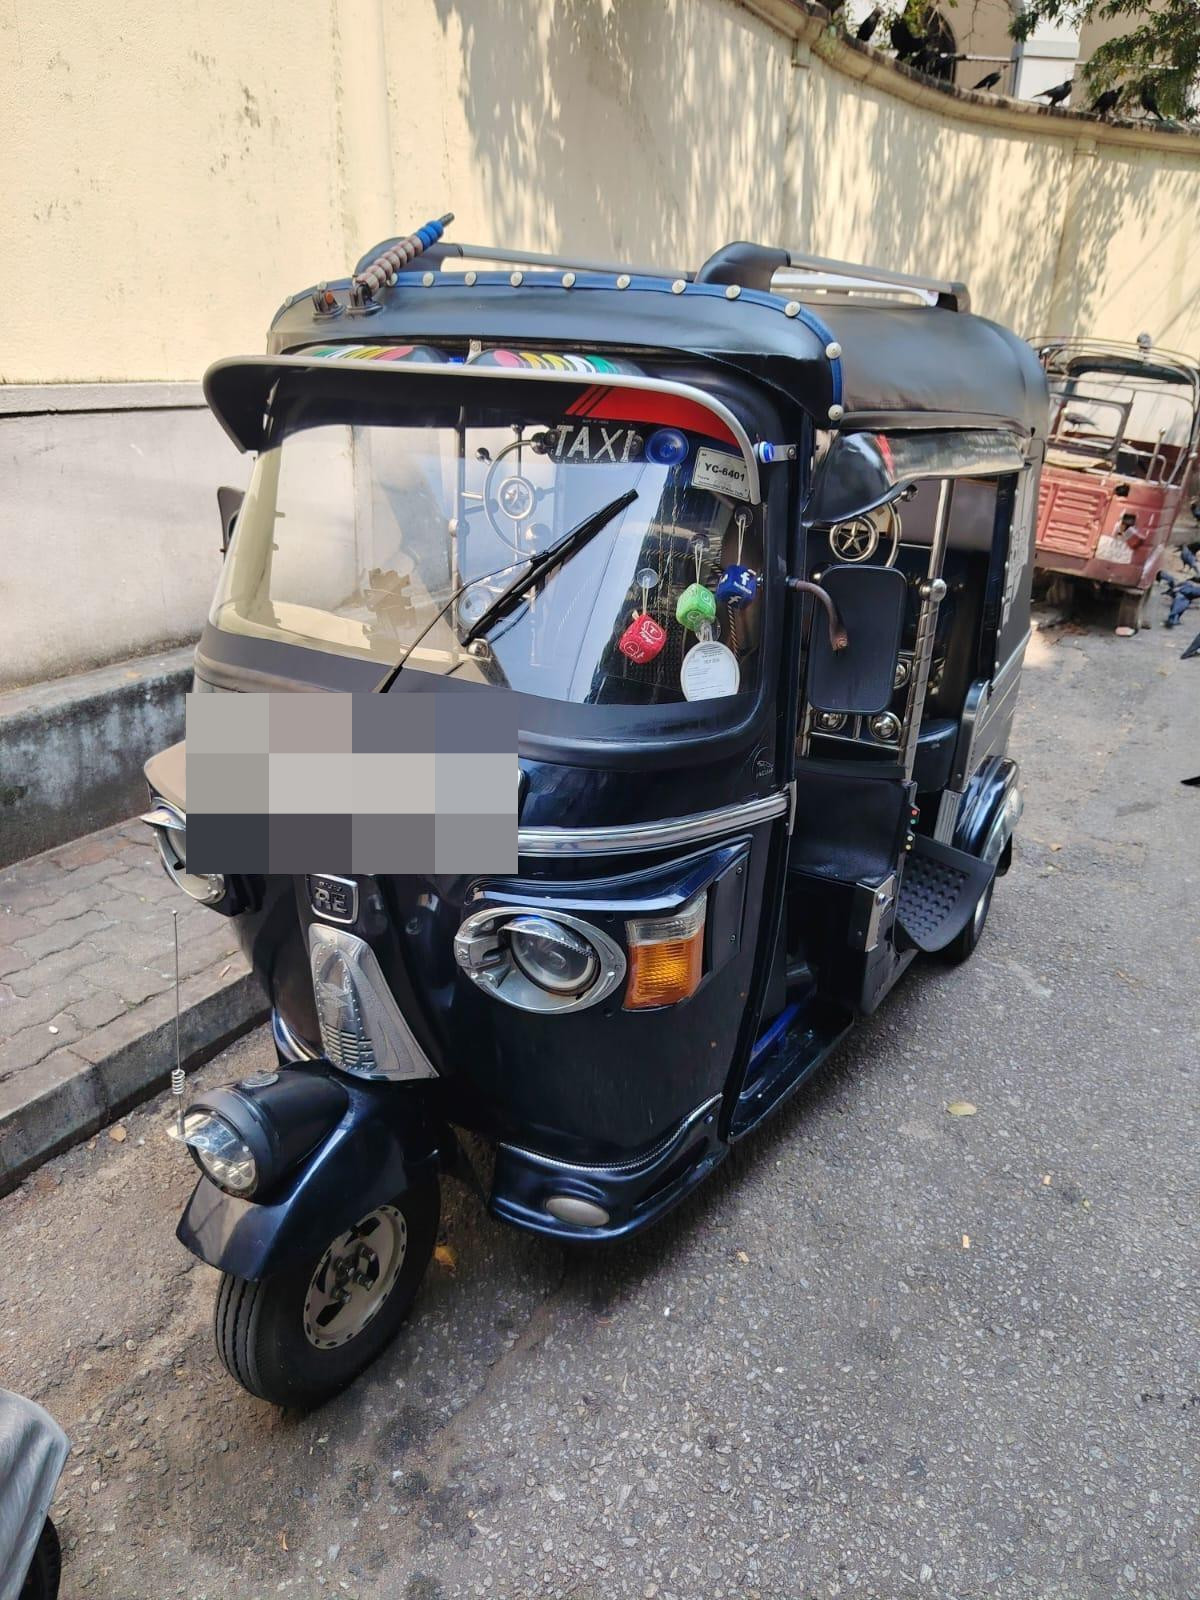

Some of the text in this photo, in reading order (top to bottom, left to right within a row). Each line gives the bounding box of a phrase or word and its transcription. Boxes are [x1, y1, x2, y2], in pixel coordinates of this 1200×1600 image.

[555, 424, 636, 463] TAXI
[705, 462, 745, 482] YC-6401
[314, 886, 348, 914] RE
